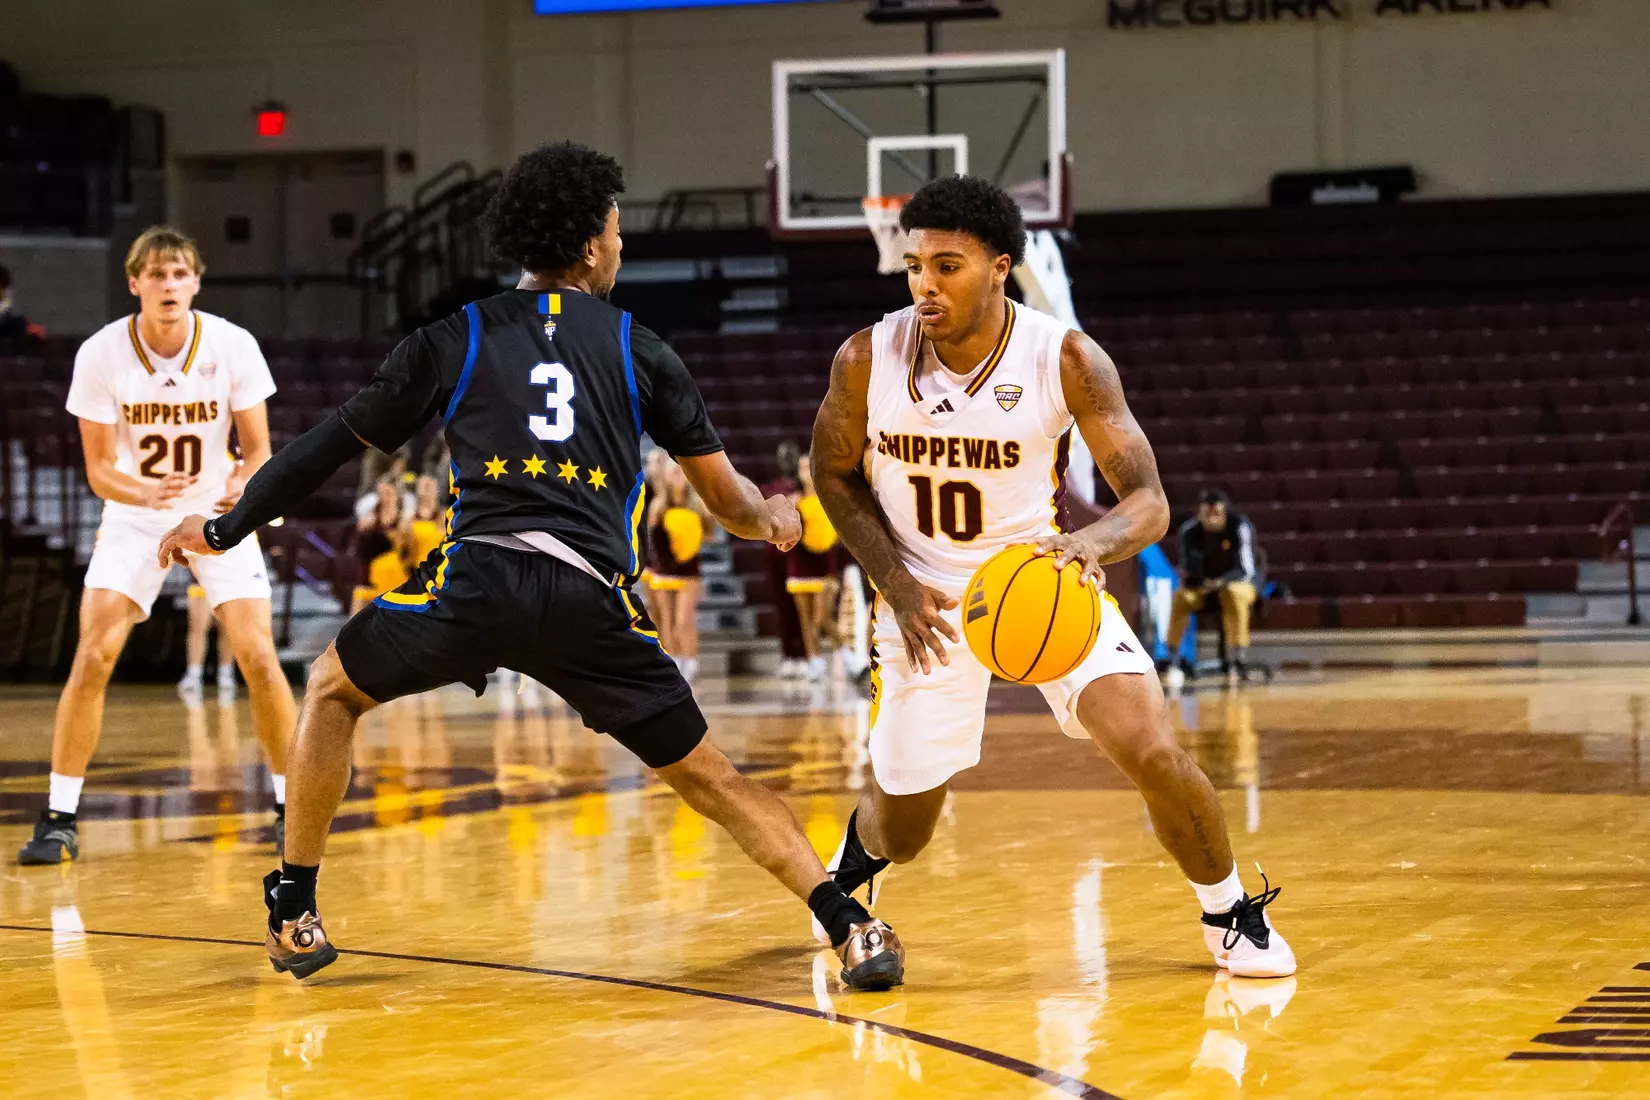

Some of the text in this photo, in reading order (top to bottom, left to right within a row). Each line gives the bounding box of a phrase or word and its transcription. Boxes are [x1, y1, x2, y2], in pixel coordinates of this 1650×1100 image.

[528, 361, 576, 443] 3
[995, 391, 1021, 401] MAC
[138, 433, 203, 480] 20
[907, 474, 985, 543] 10
